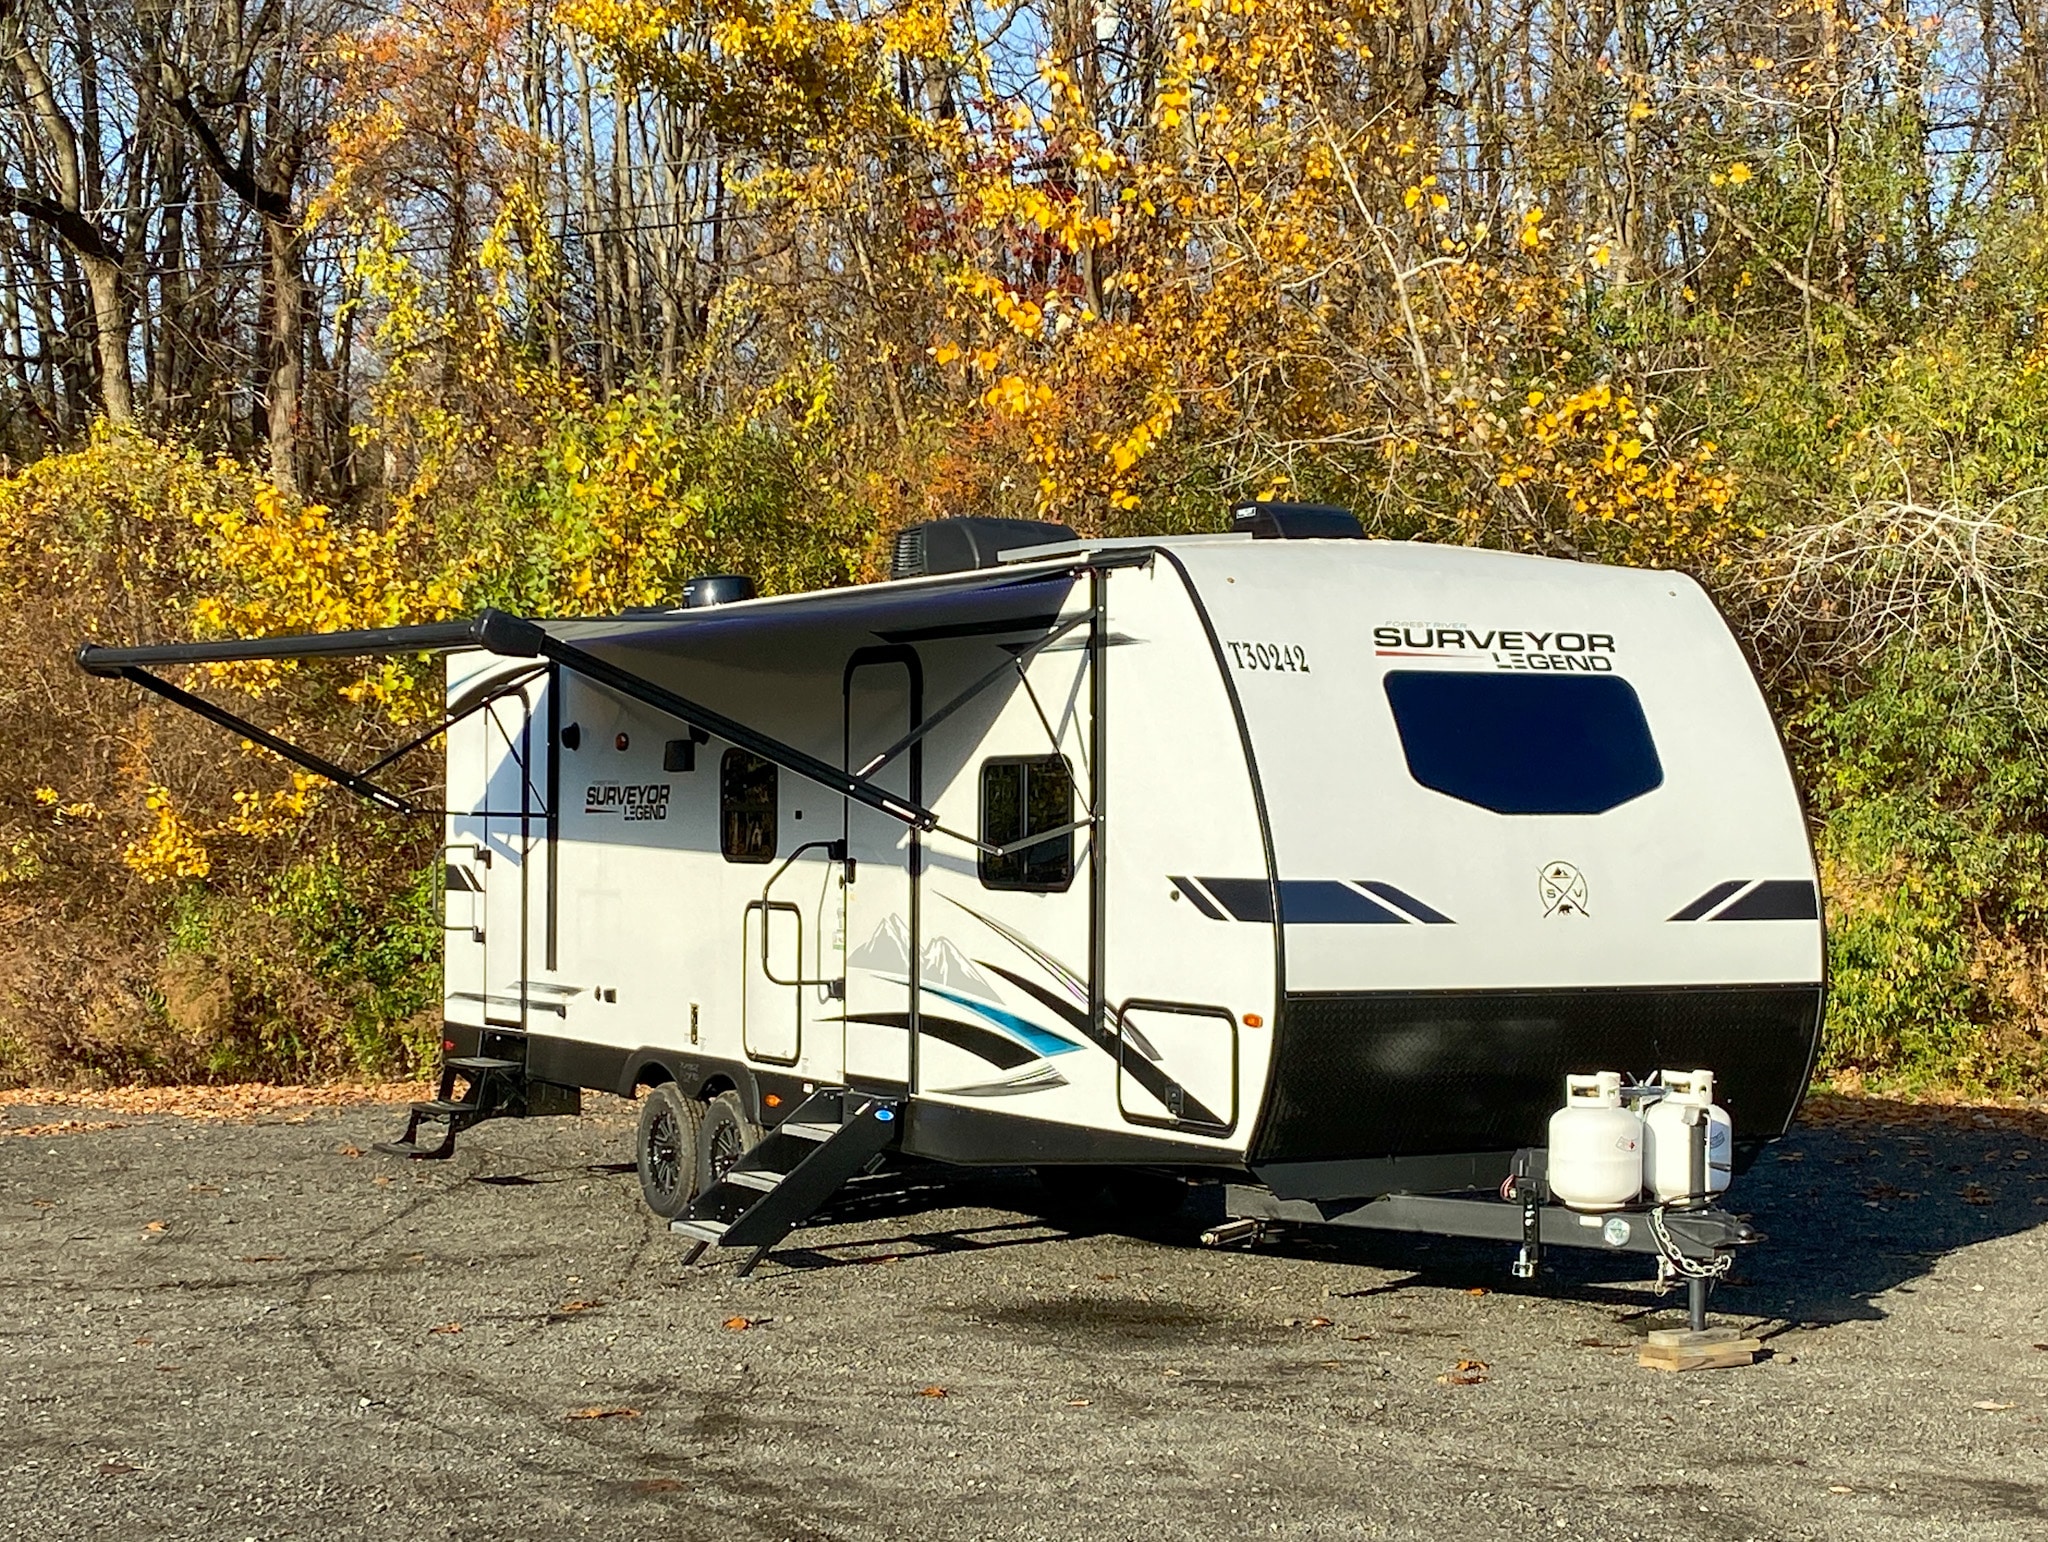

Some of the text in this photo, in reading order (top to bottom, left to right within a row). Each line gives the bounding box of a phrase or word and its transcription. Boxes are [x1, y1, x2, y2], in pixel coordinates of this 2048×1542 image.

[1384, 620, 1467, 629] FOREST RIVER
[1373, 627, 1616, 653] SURVEYOR
[1226, 641, 1310, 673] T30242
[1491, 652, 1612, 671] LEGEND
[586, 785, 670, 805] SURVEYOR
[624, 805, 666, 821] LEGEND
[1546, 888, 1583, 898] S V
